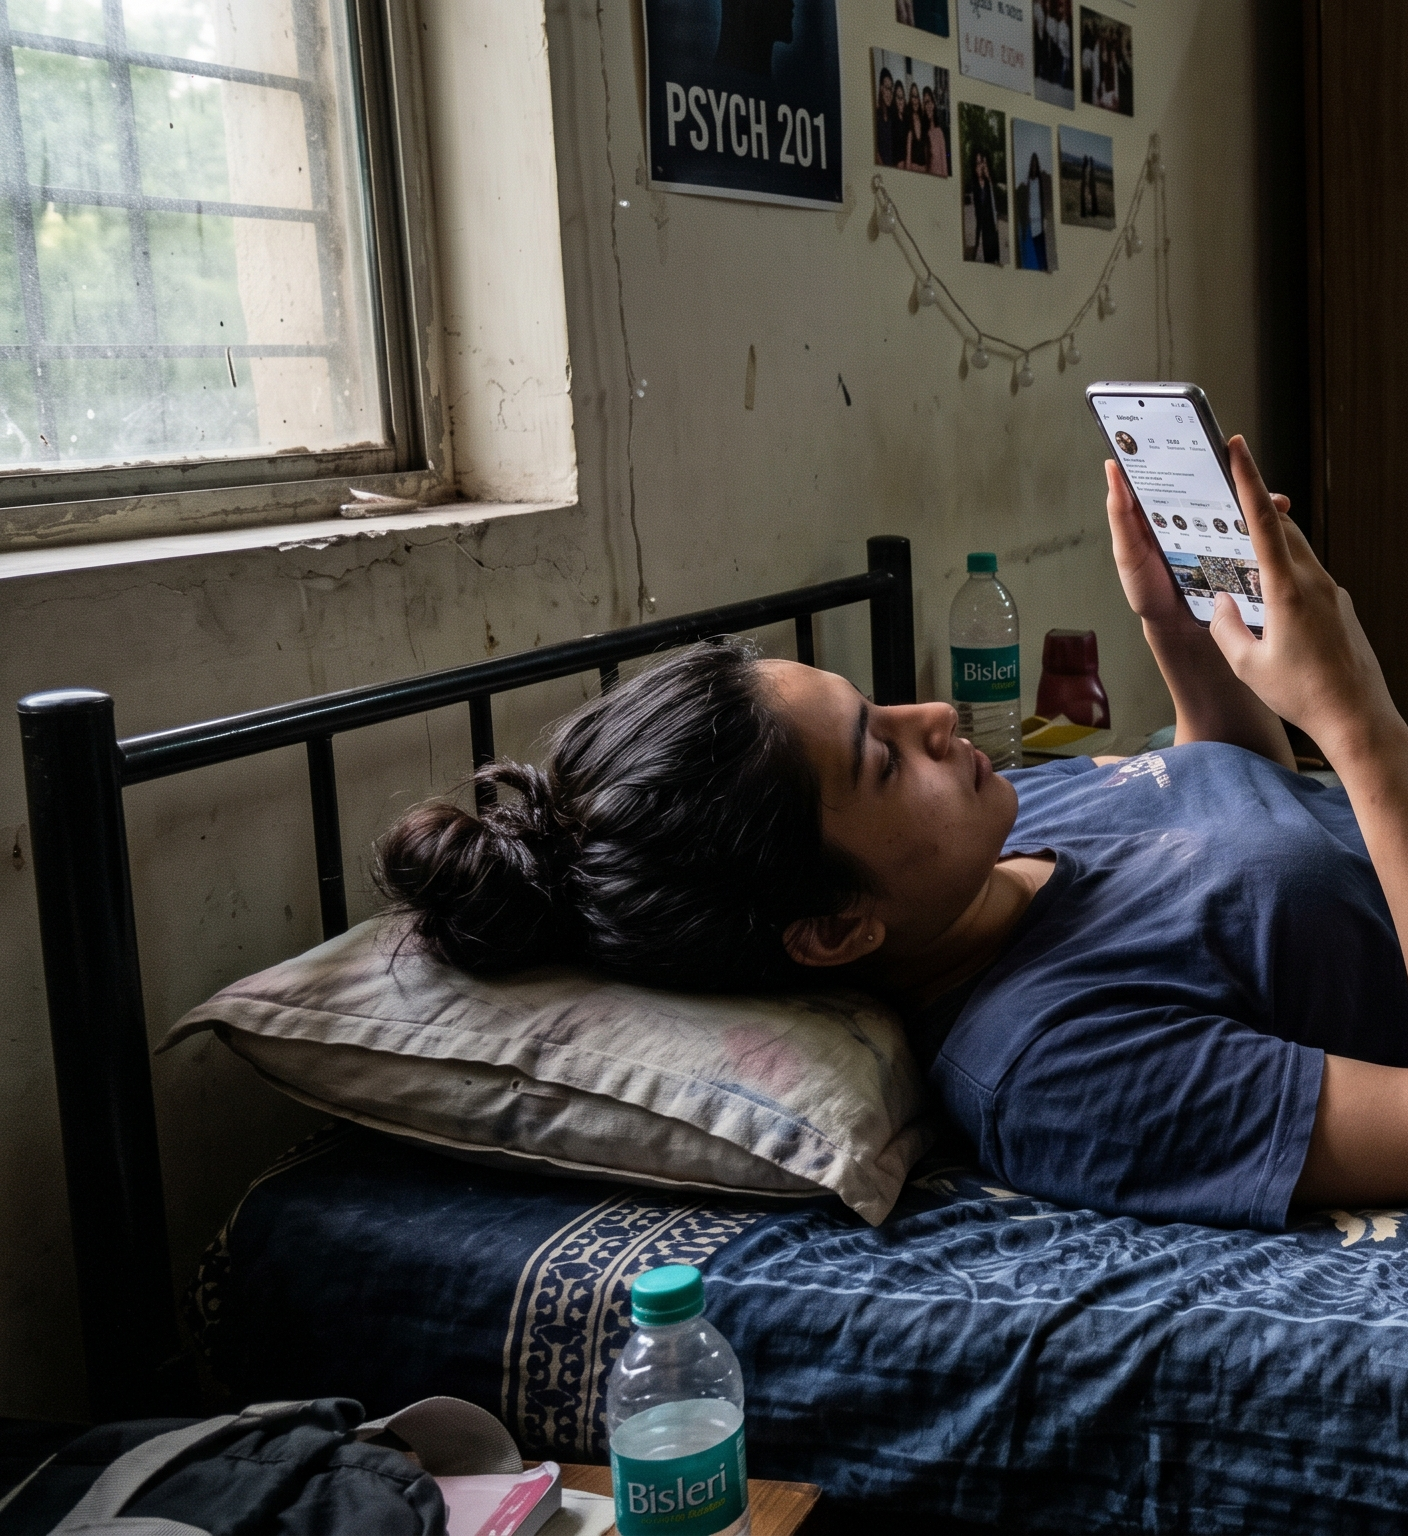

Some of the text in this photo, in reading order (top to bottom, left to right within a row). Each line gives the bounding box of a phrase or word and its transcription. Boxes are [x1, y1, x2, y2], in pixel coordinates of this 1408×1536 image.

[665, 81, 828, 170] PSYCH 201
[963, 659, 1017, 681] Bisleri
[627, 1462, 728, 1515] Bisleri
